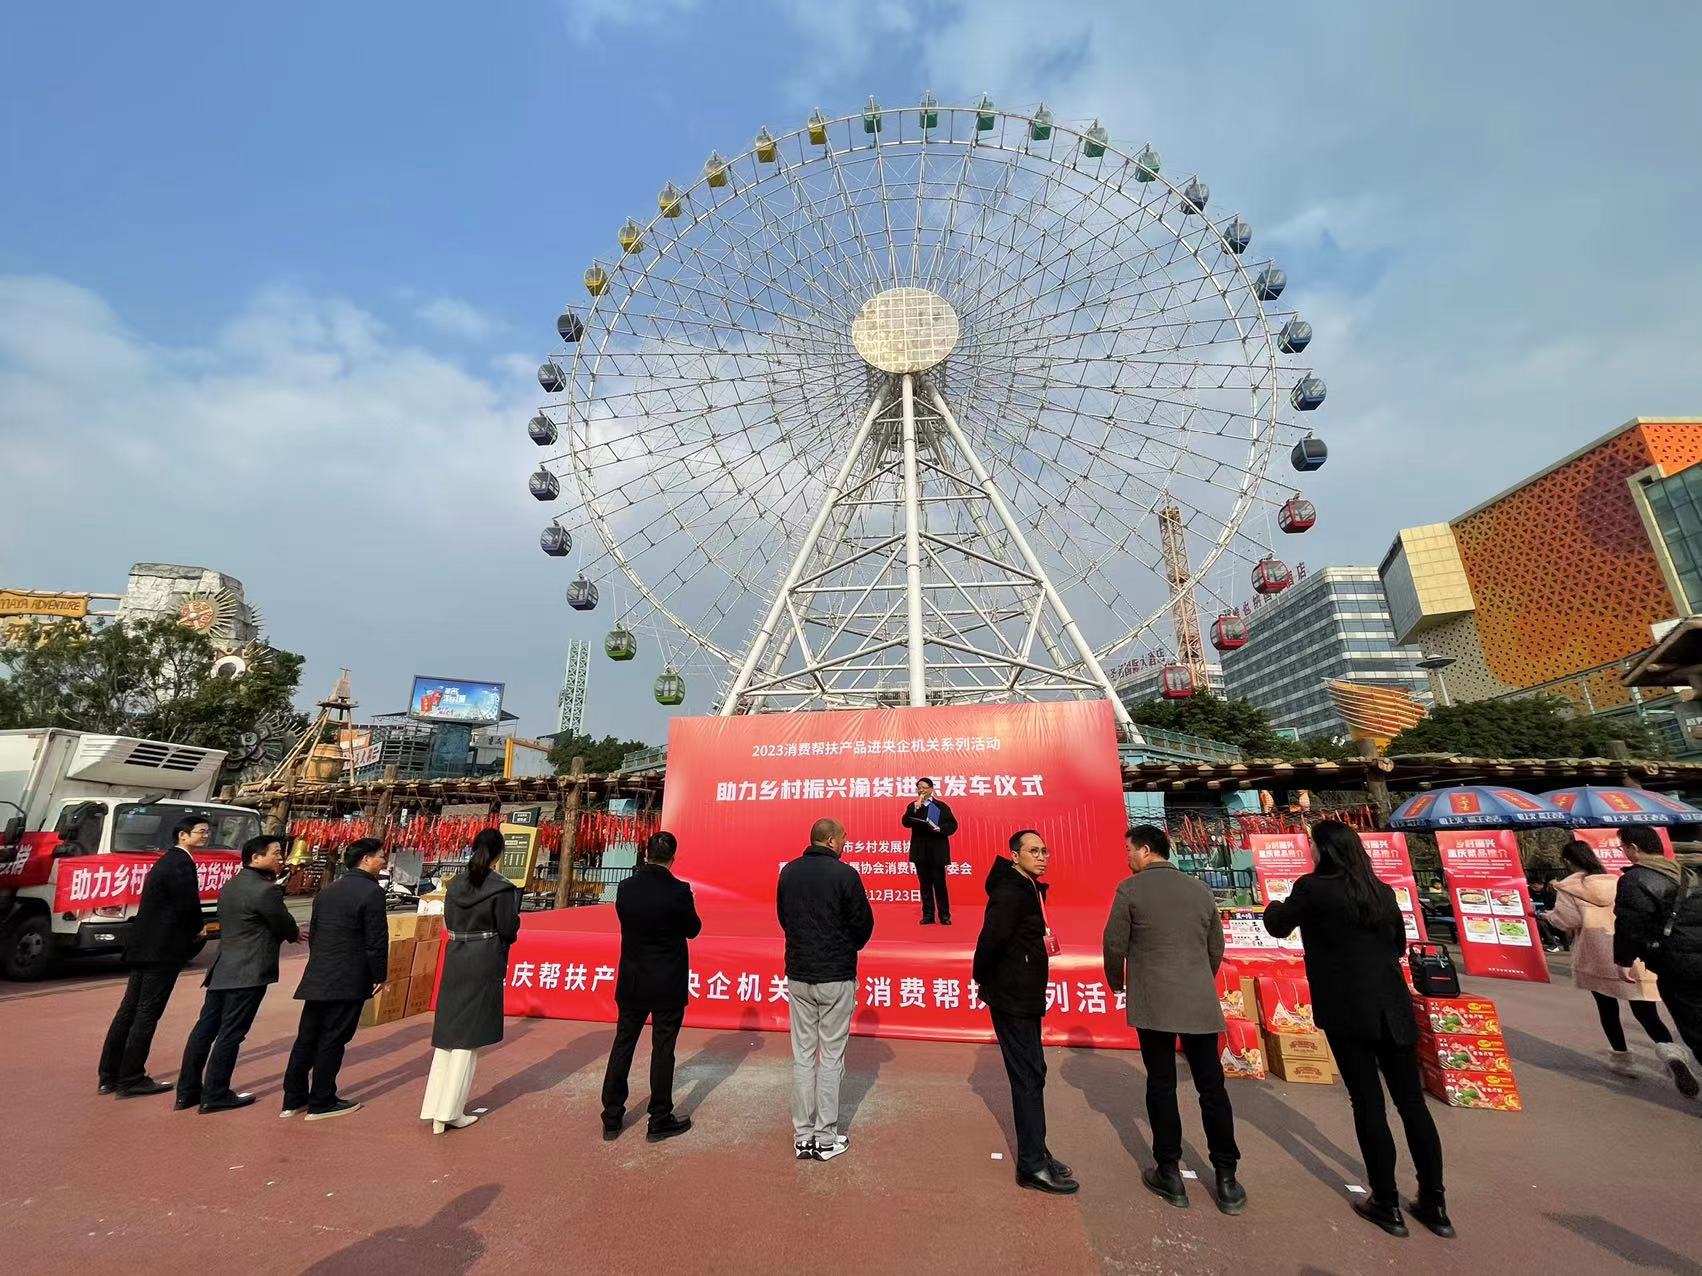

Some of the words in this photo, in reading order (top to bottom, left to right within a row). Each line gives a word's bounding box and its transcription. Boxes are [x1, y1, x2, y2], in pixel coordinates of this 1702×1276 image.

[1, 598, 29, 609] MAYA
[31, 599, 81, 611] ADVENTURE
[752, 736, 1001, 757] 2023消费帮扶产品进央企机关系列活动
[716, 774, 1044, 801] 助力乡村振兴渝货进京发车仪式
[503, 961, 615, 992] 庆帮扶产
